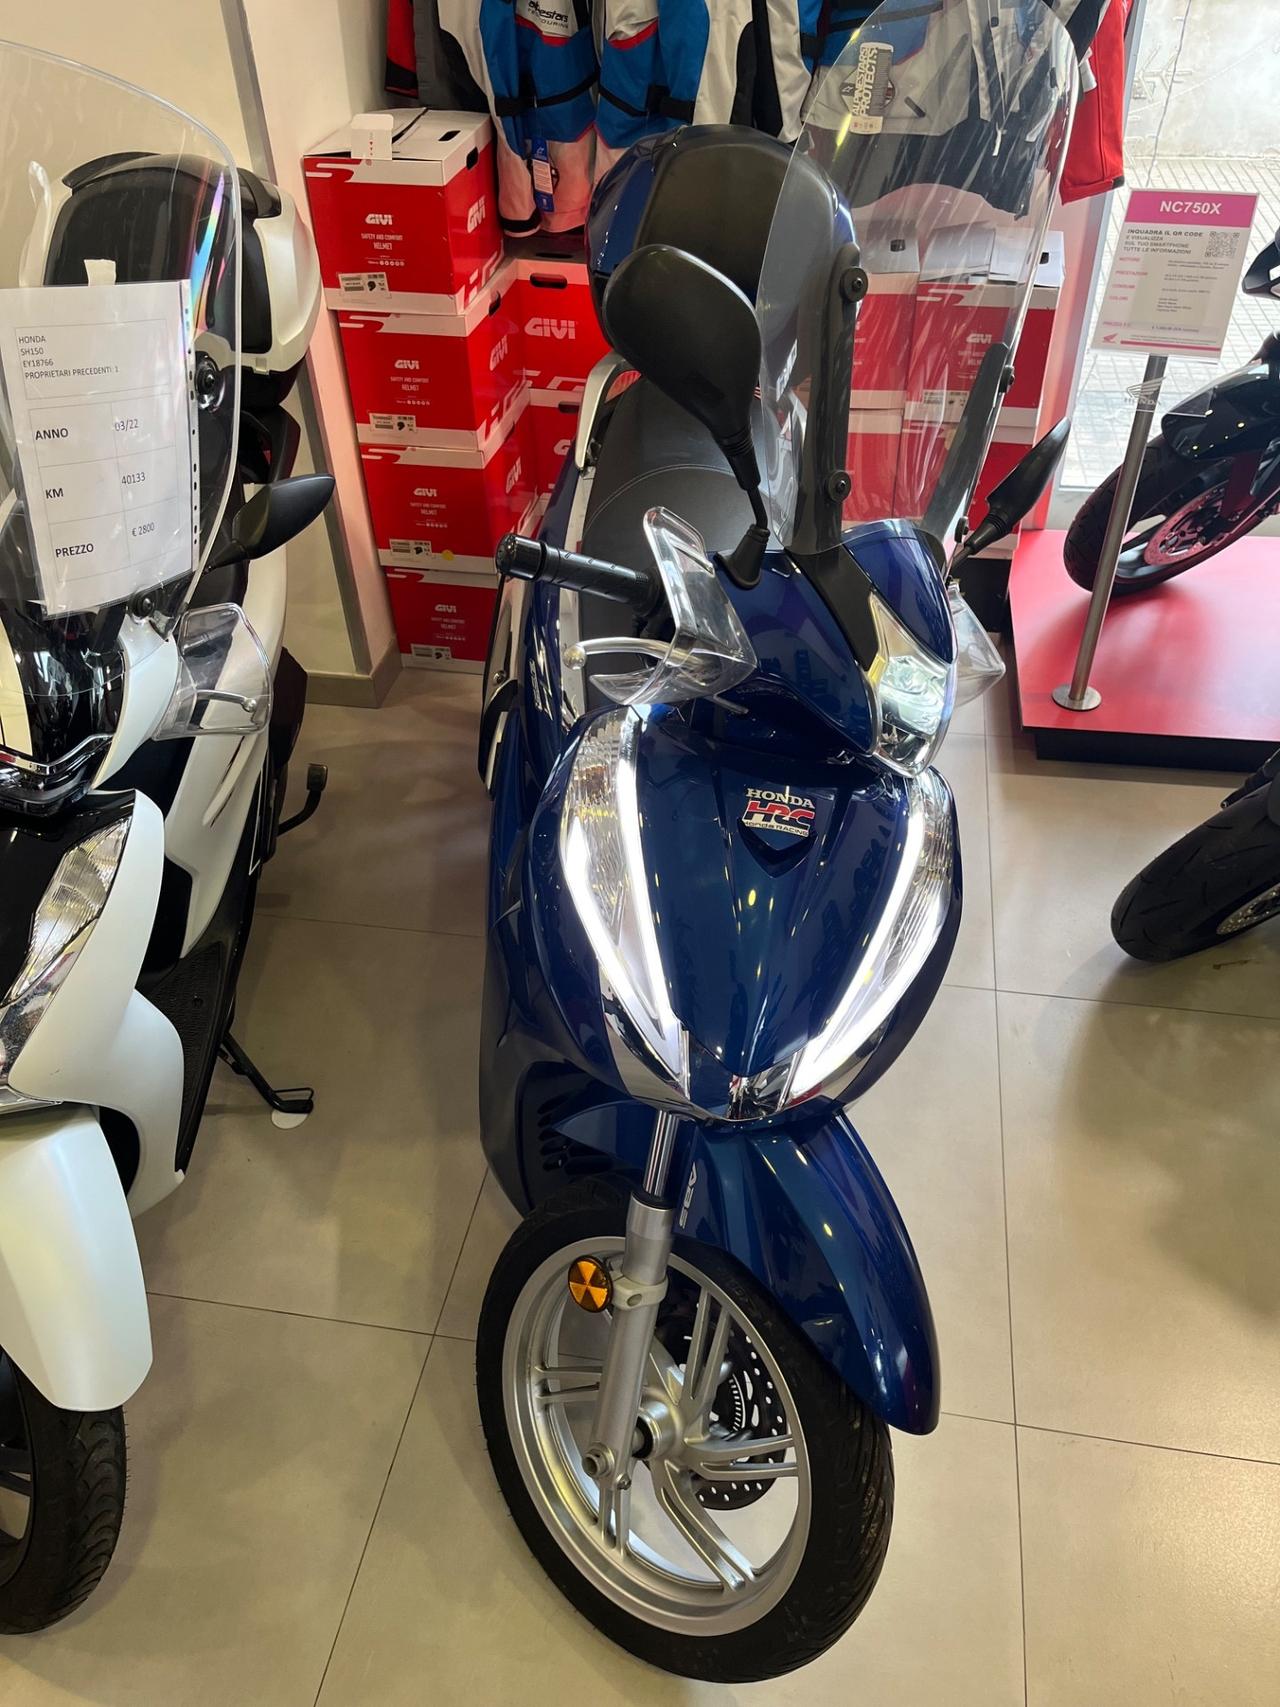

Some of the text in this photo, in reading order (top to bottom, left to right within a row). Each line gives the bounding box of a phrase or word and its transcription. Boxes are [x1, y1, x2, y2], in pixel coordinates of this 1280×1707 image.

[852, 46, 868, 116] ALPINESTARS
[467, 195, 486, 234] GIVI
[1160, 200, 1222, 215] NC750X
[365, 213, 393, 226] GIVI
[18, 335, 46, 344] HONDA
[524, 317, 577, 340] GIVI
[966, 333, 992, 344] GIVI
[20, 347, 44, 356] SH150
[489, 334, 508, 371] GIVI
[22, 359, 54, 368] EY18766
[25, 369, 71, 380] PROPRIETARI
[394, 359, 420, 370] GIVI
[34, 418, 140, 441] ANNO 03/22
[45, 472, 146, 500] KM 40133
[505, 456, 522, 494] GIVI
[413, 487, 438, 497] GIVI
[55, 522, 155, 558] PREZZO € 2800
[434, 604, 457, 613] GIVI
[745, 788, 816, 810] HONDA
[742, 800, 816, 831] HRC
[679, 1161, 698, 1230] ABS
